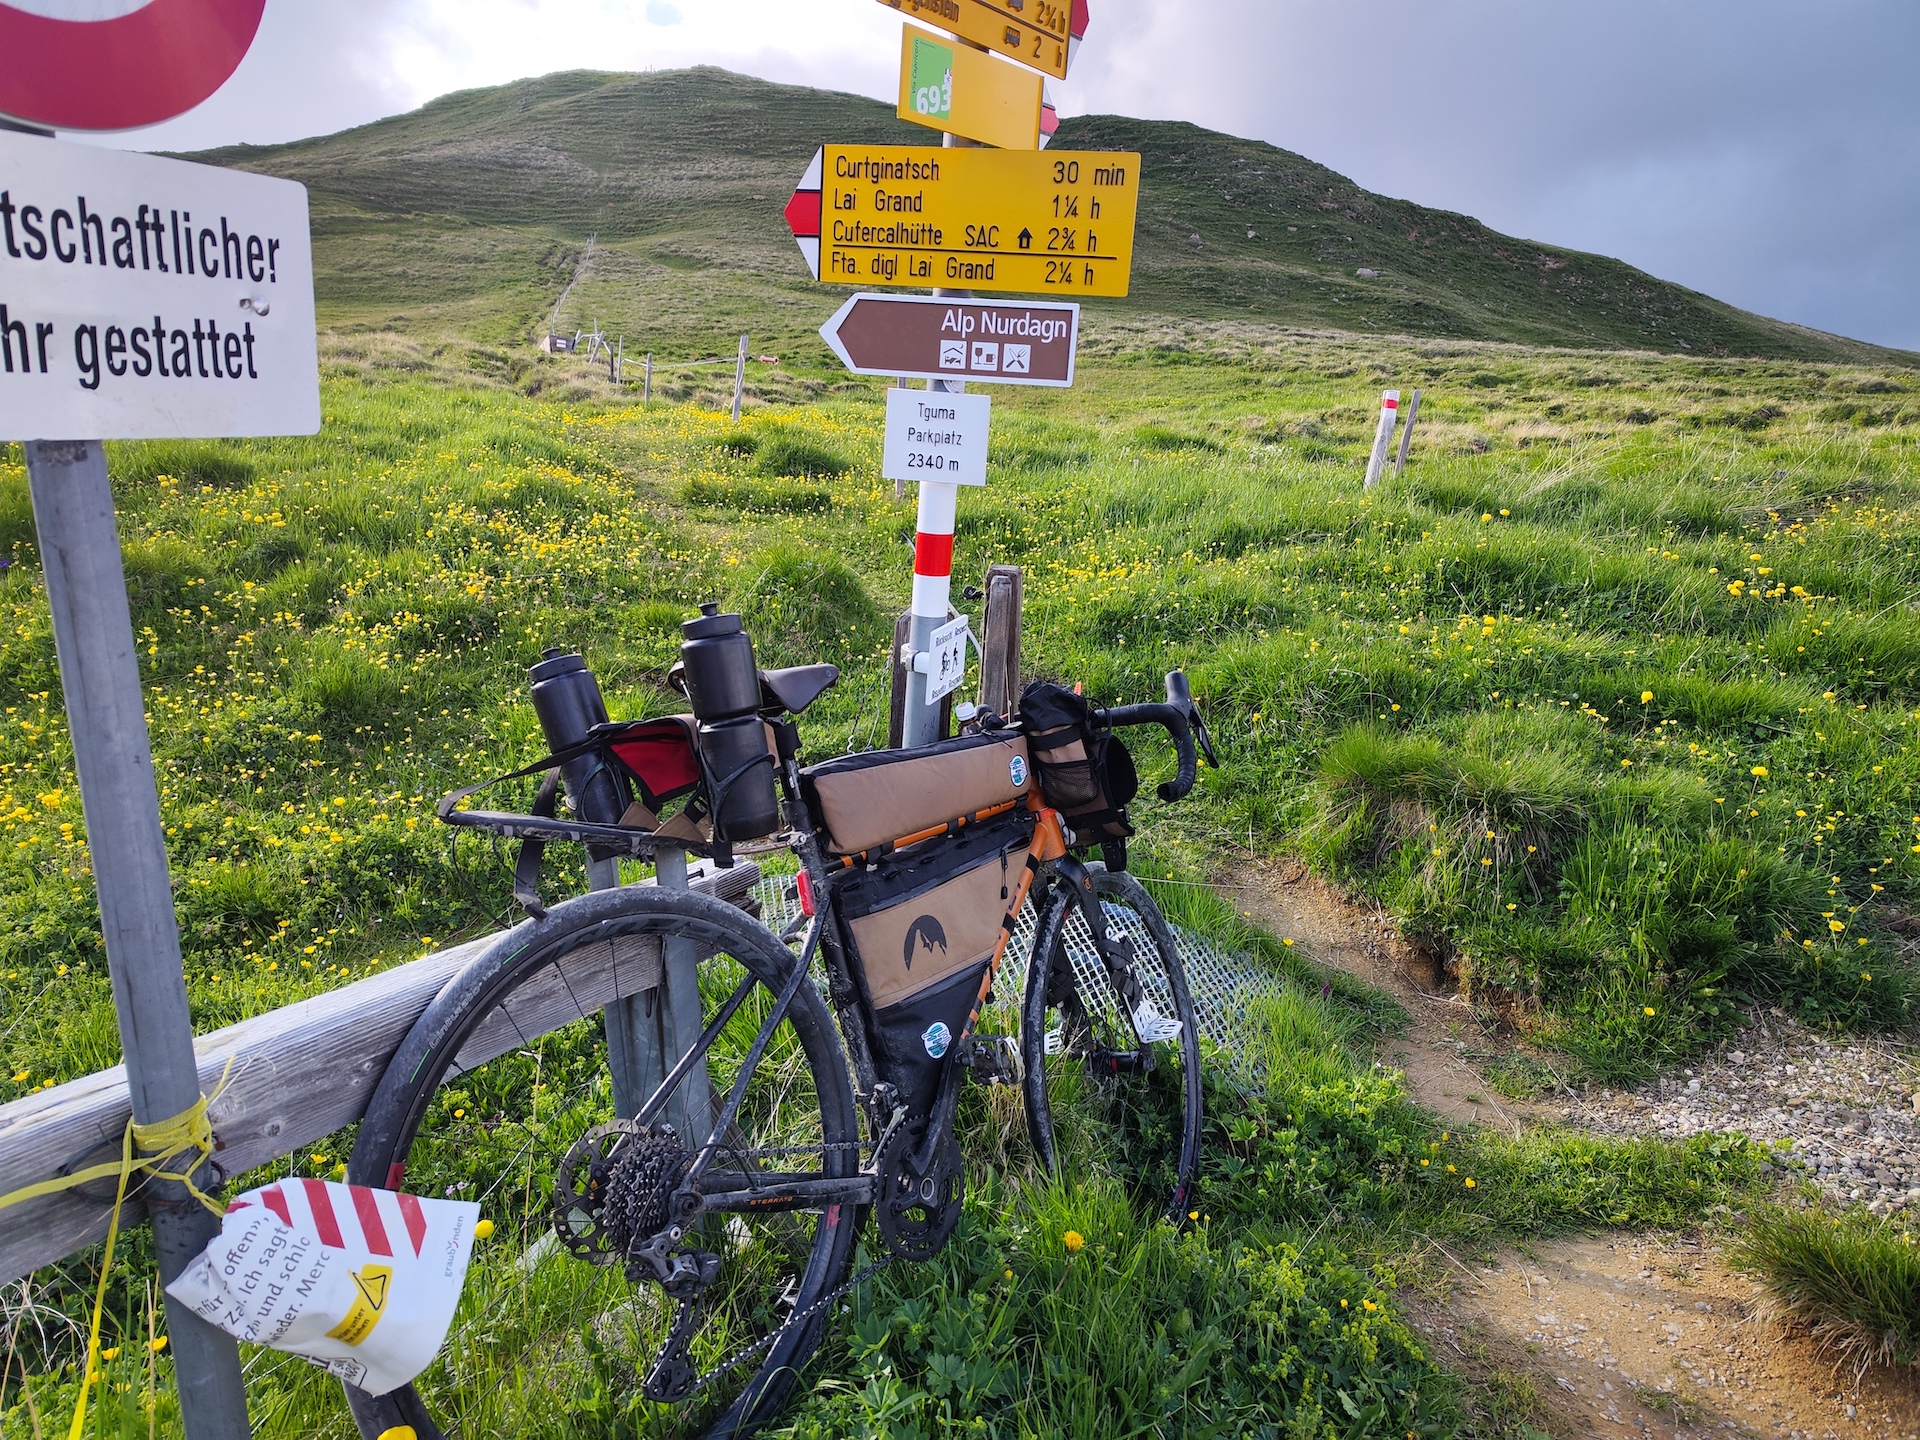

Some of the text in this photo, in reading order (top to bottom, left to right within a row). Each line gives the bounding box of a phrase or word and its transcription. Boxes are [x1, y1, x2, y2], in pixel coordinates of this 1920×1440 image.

[1058, 11, 1066, 34] h
[1033, 35, 1042, 59] 2
[1055, 45, 1062, 68] h
[916, 83, 952, 115] 693
[835, 155, 1125, 187] Curtginatsch 30 min
[834, 188, 1101, 220] Lai Grand 1¼ h
[0, 190, 281, 284] tschaftlicher
[832, 219, 1098, 253] Cufercalhütte SAC 2¾ h
[831, 251, 1095, 286] Fta. digl Lai Grand 2¼ h
[940, 307, 1068, 344] Alp Nurdagn
[0, 304, 259, 391] hr gestattet
[918, 402, 956, 422] Tguma
[907, 427, 963, 448] Parkplatz
[907, 452, 960, 472] 2340 m
[238, 1269, 263, 1295] Ich
[259, 1223, 290, 1267] sagt
[257, 1282, 284, 1317] und
[279, 1236, 311, 1281] schlo
